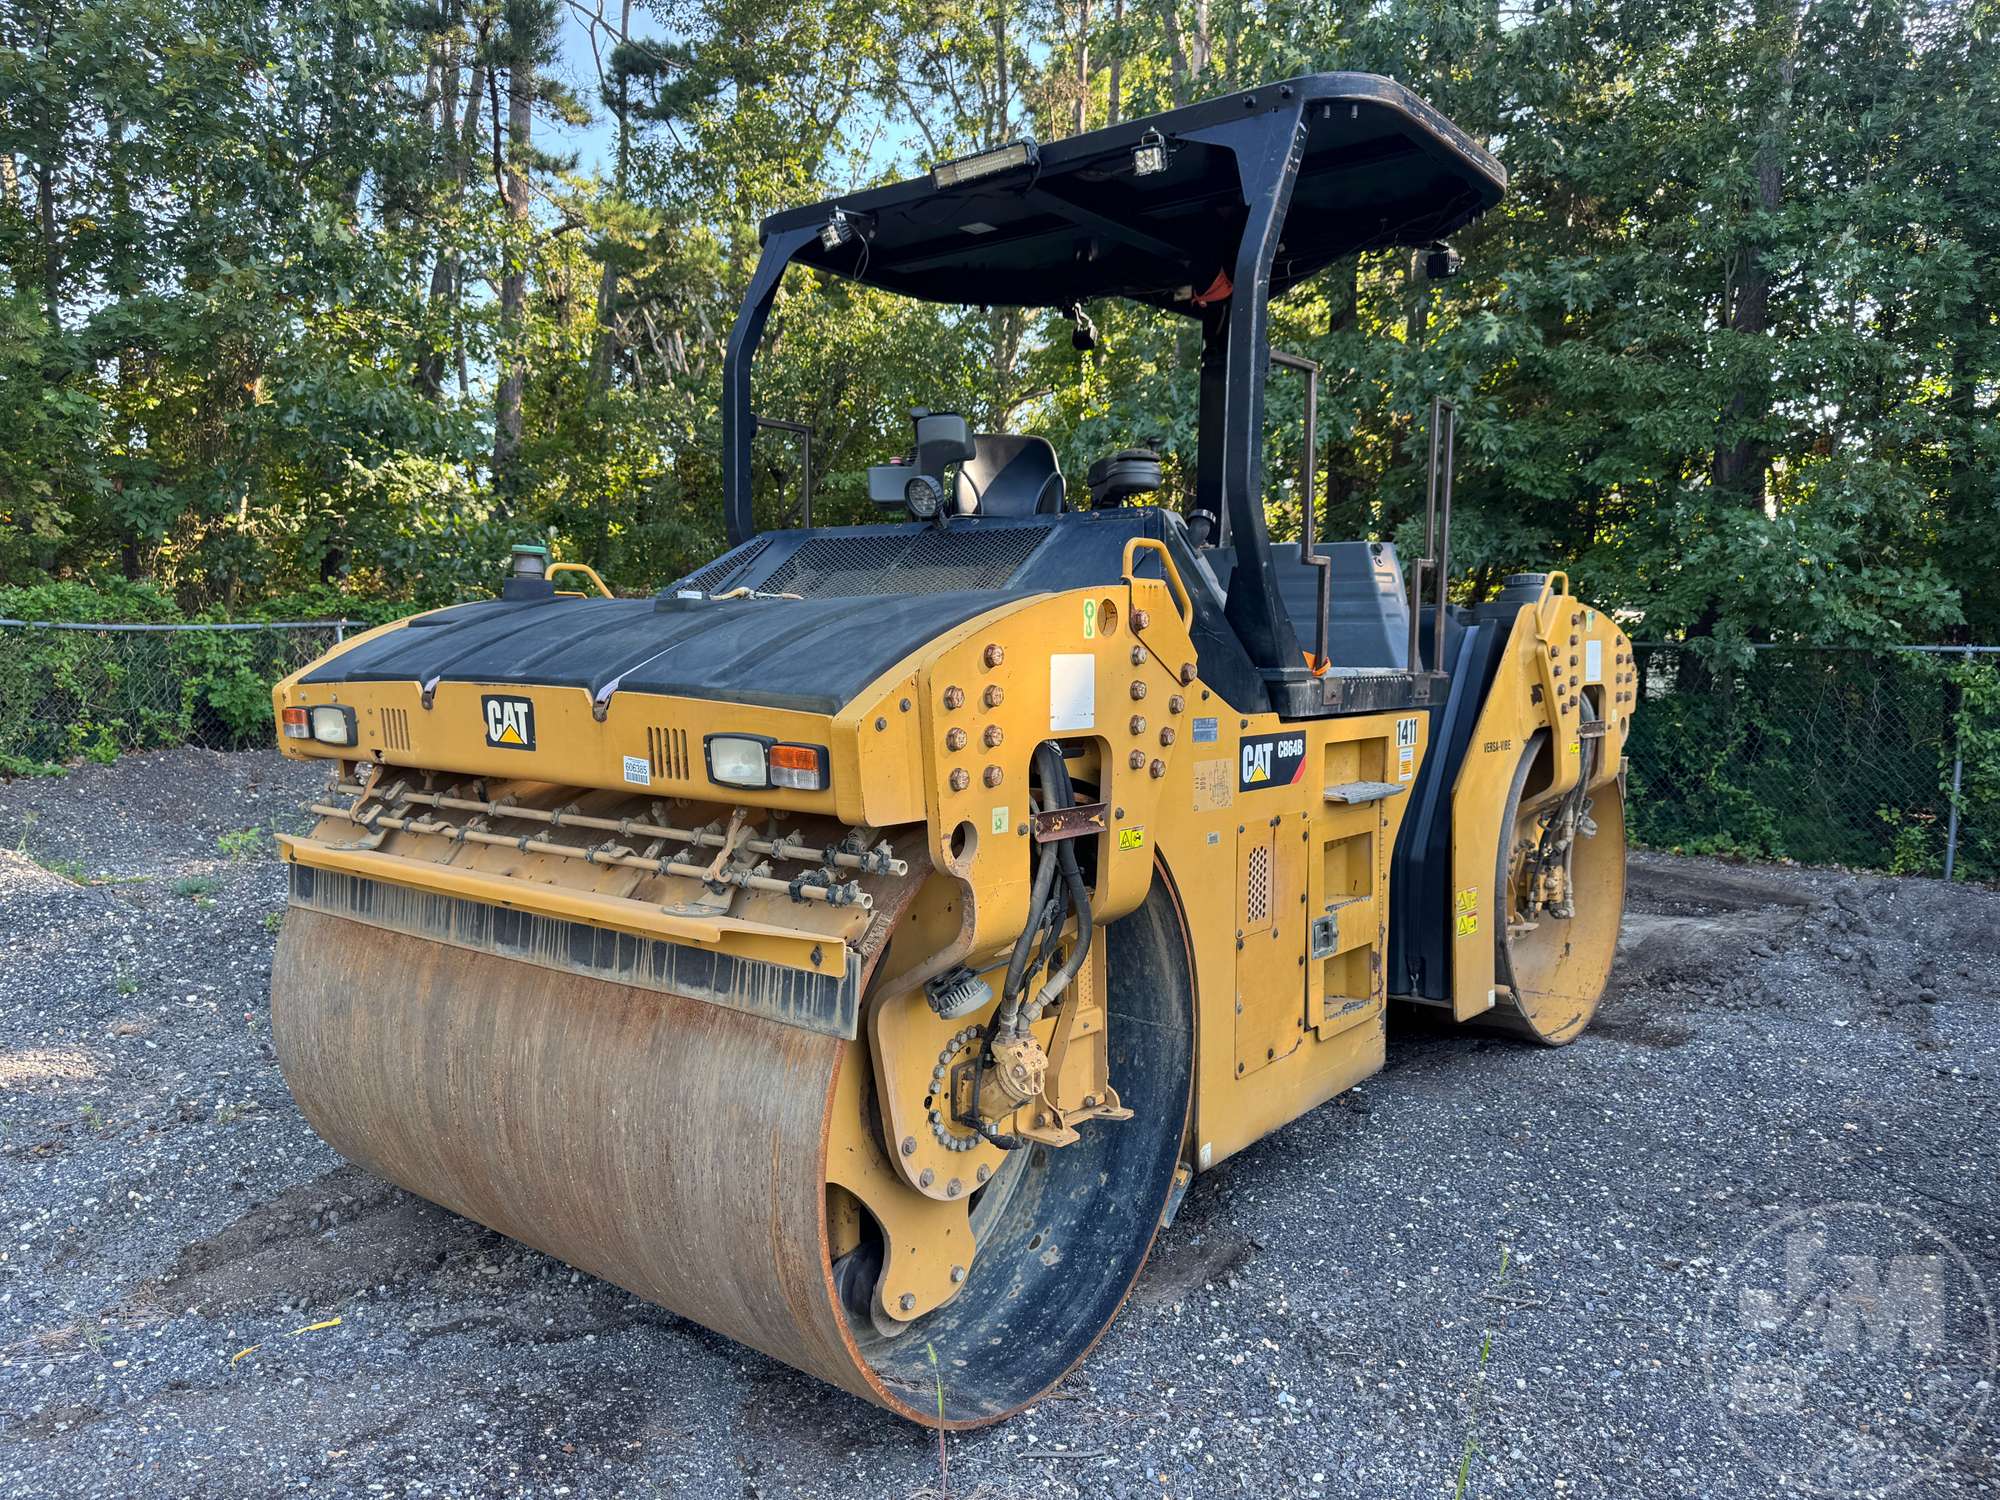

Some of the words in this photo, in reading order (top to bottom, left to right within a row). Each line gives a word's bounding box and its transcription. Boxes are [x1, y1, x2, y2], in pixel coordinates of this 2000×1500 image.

[487, 700, 529, 745] CAT
[1397, 719, 1417, 746] 1411
[1242, 743, 1274, 783] CAT
[1277, 739, 1304, 758] CB64B
